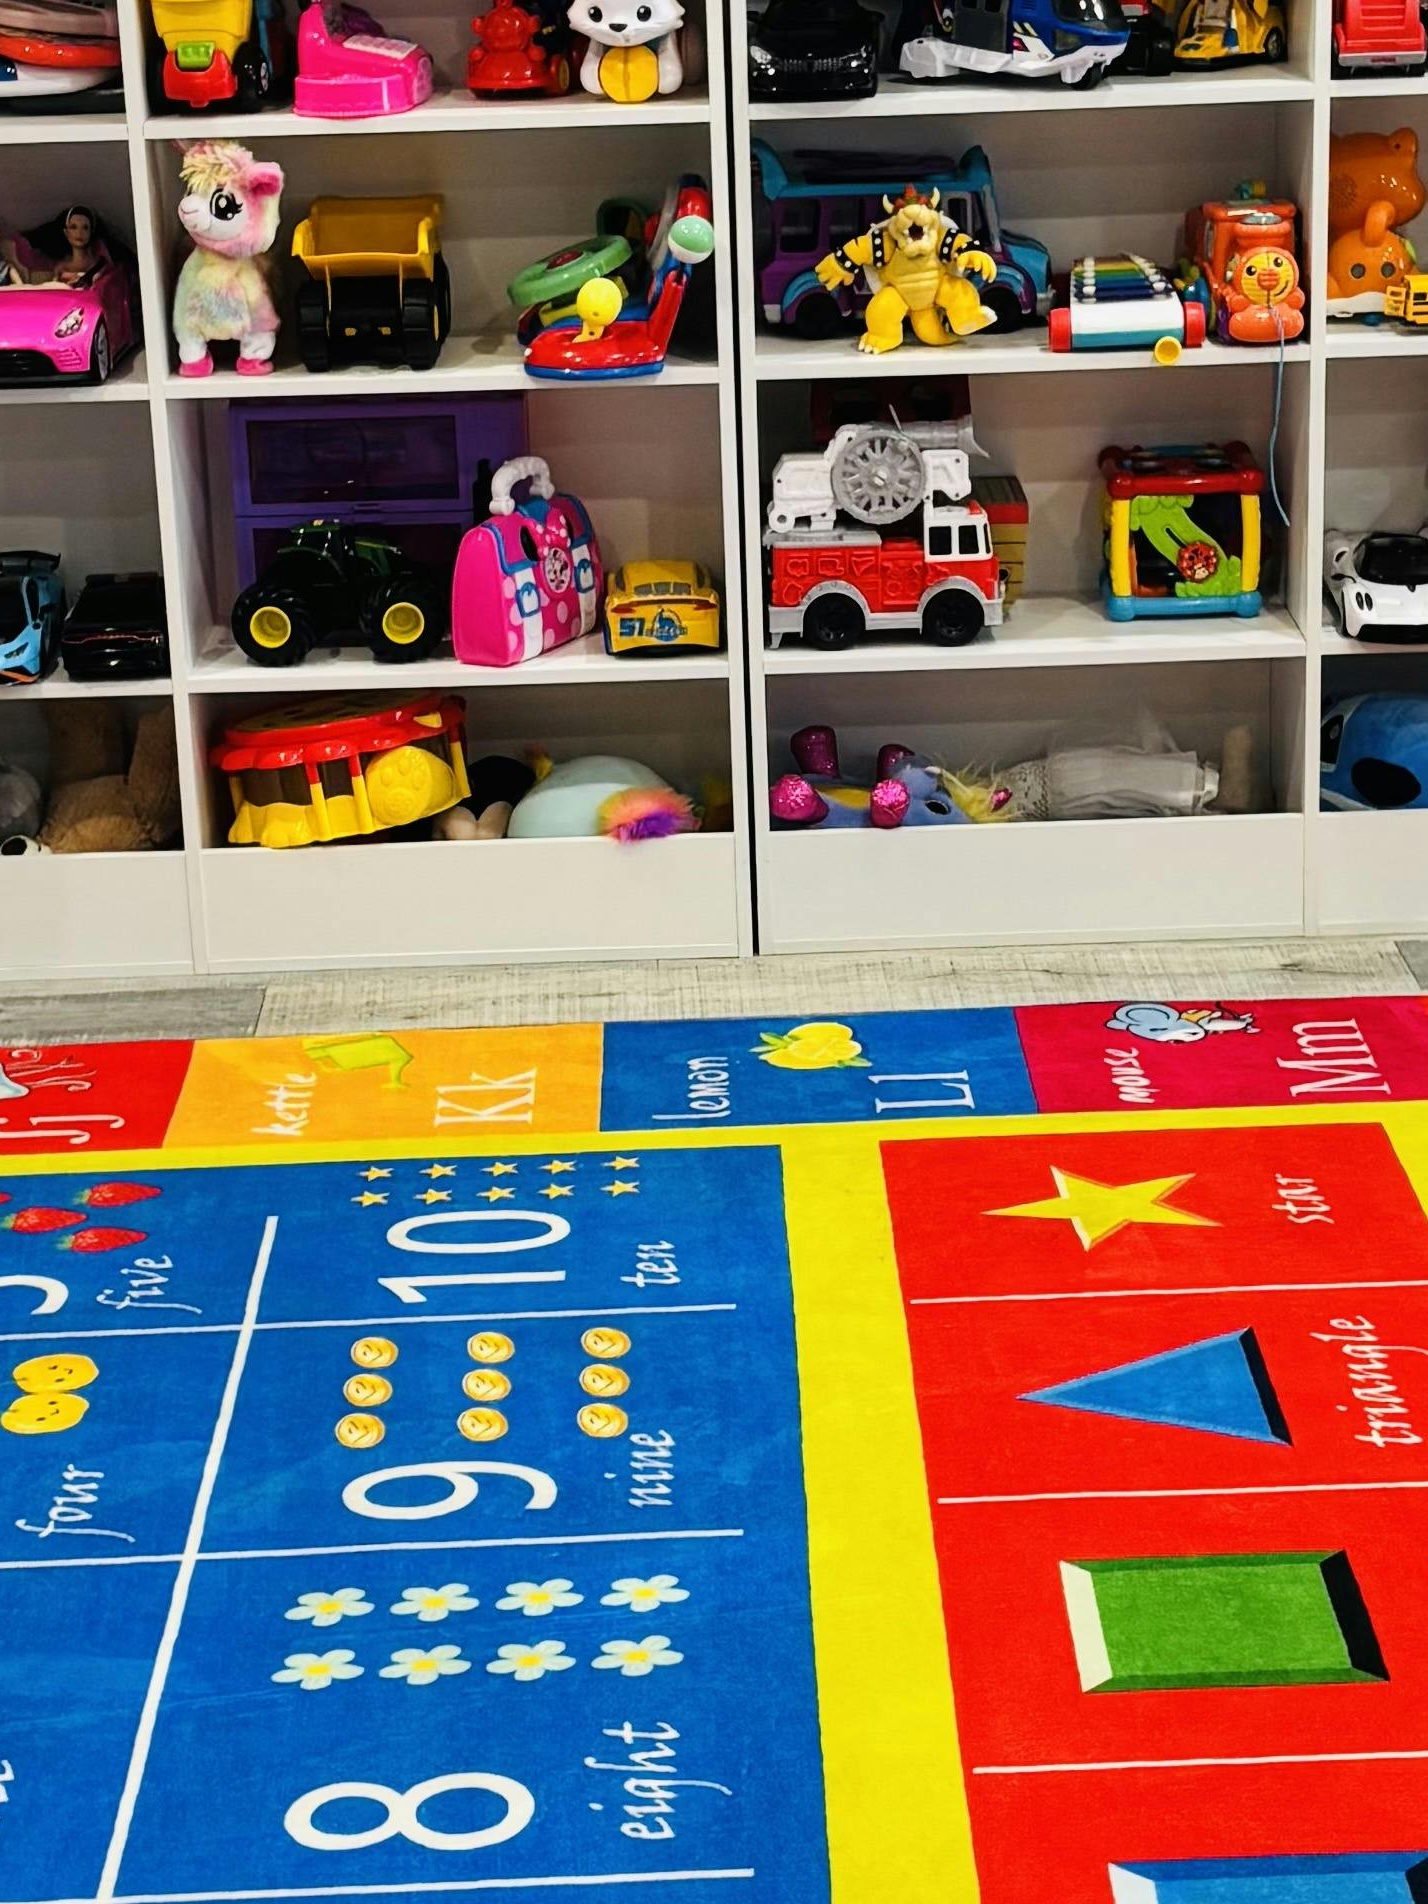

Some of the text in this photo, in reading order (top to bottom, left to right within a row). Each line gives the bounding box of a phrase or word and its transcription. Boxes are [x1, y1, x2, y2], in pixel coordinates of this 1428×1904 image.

[651, 1056, 732, 1120] lemon
[1103, 1047, 1159, 1104] mouse
[1276, 1018, 1392, 1097] Mm
[432, 1068, 538, 1127] Kk
[867, 1069, 976, 1114] Ll
[1271, 1173, 1334, 1224] star
[96, 1254, 203, 1314] five
[377, 1209, 571, 1304] 10
[620, 1240, 682, 1288] ten
[341, 1460, 558, 1521] 9
[603, 1429, 676, 1508] nine
[14, 1463, 136, 1543] four
[283, 1772, 536, 1851] 8
[583, 1721, 733, 1840] eight
